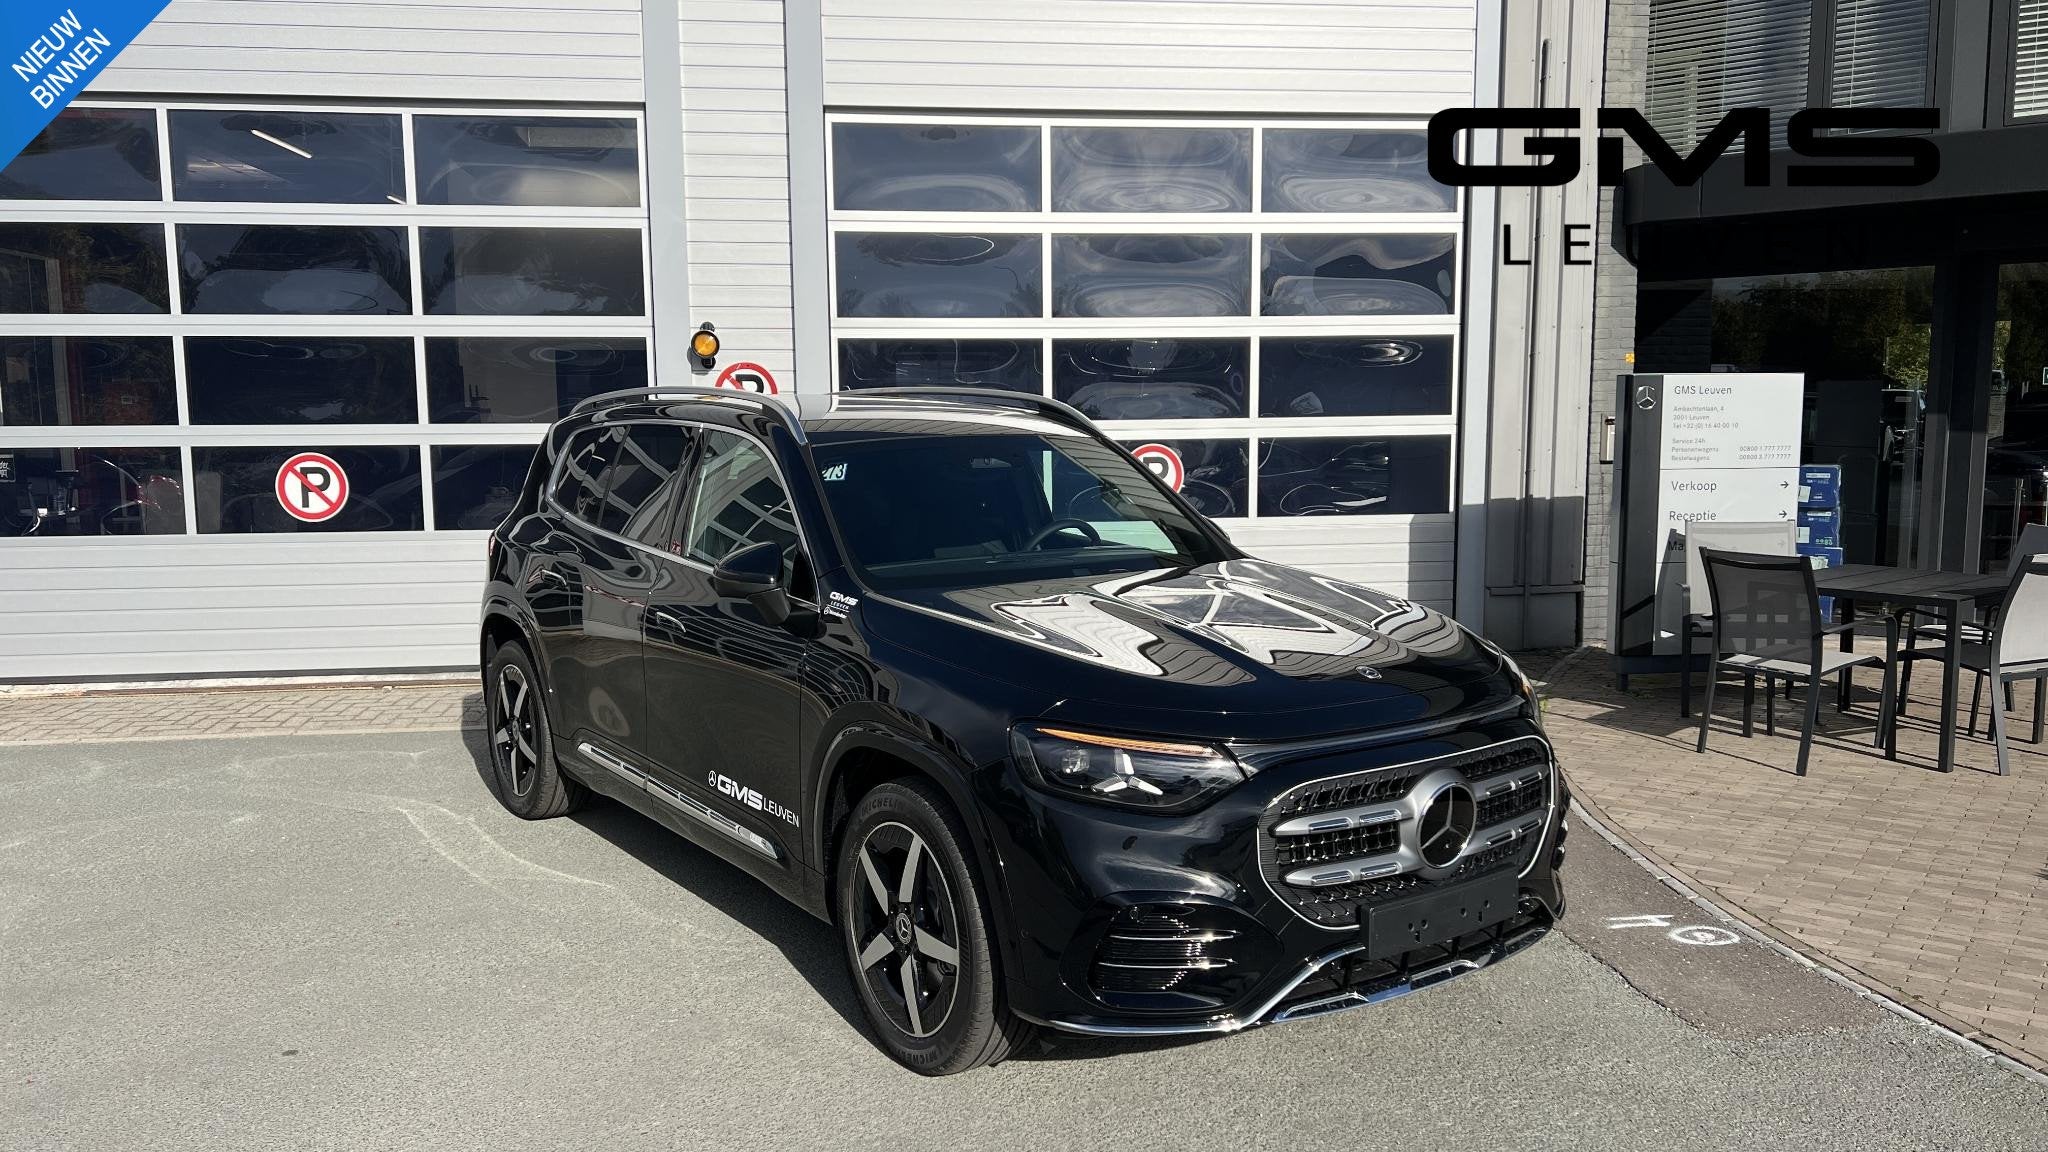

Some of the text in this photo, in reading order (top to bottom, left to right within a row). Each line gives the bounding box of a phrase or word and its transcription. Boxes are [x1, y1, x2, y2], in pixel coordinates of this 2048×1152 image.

[1674, 385, 1732, 395] GMS Leuven
[1671, 480, 1717, 493] Verkoop
[1669, 510, 1717, 521] Receptie
[829, 591, 859, 606] GMS
[717, 773, 800, 828] GMS LEUVEN
